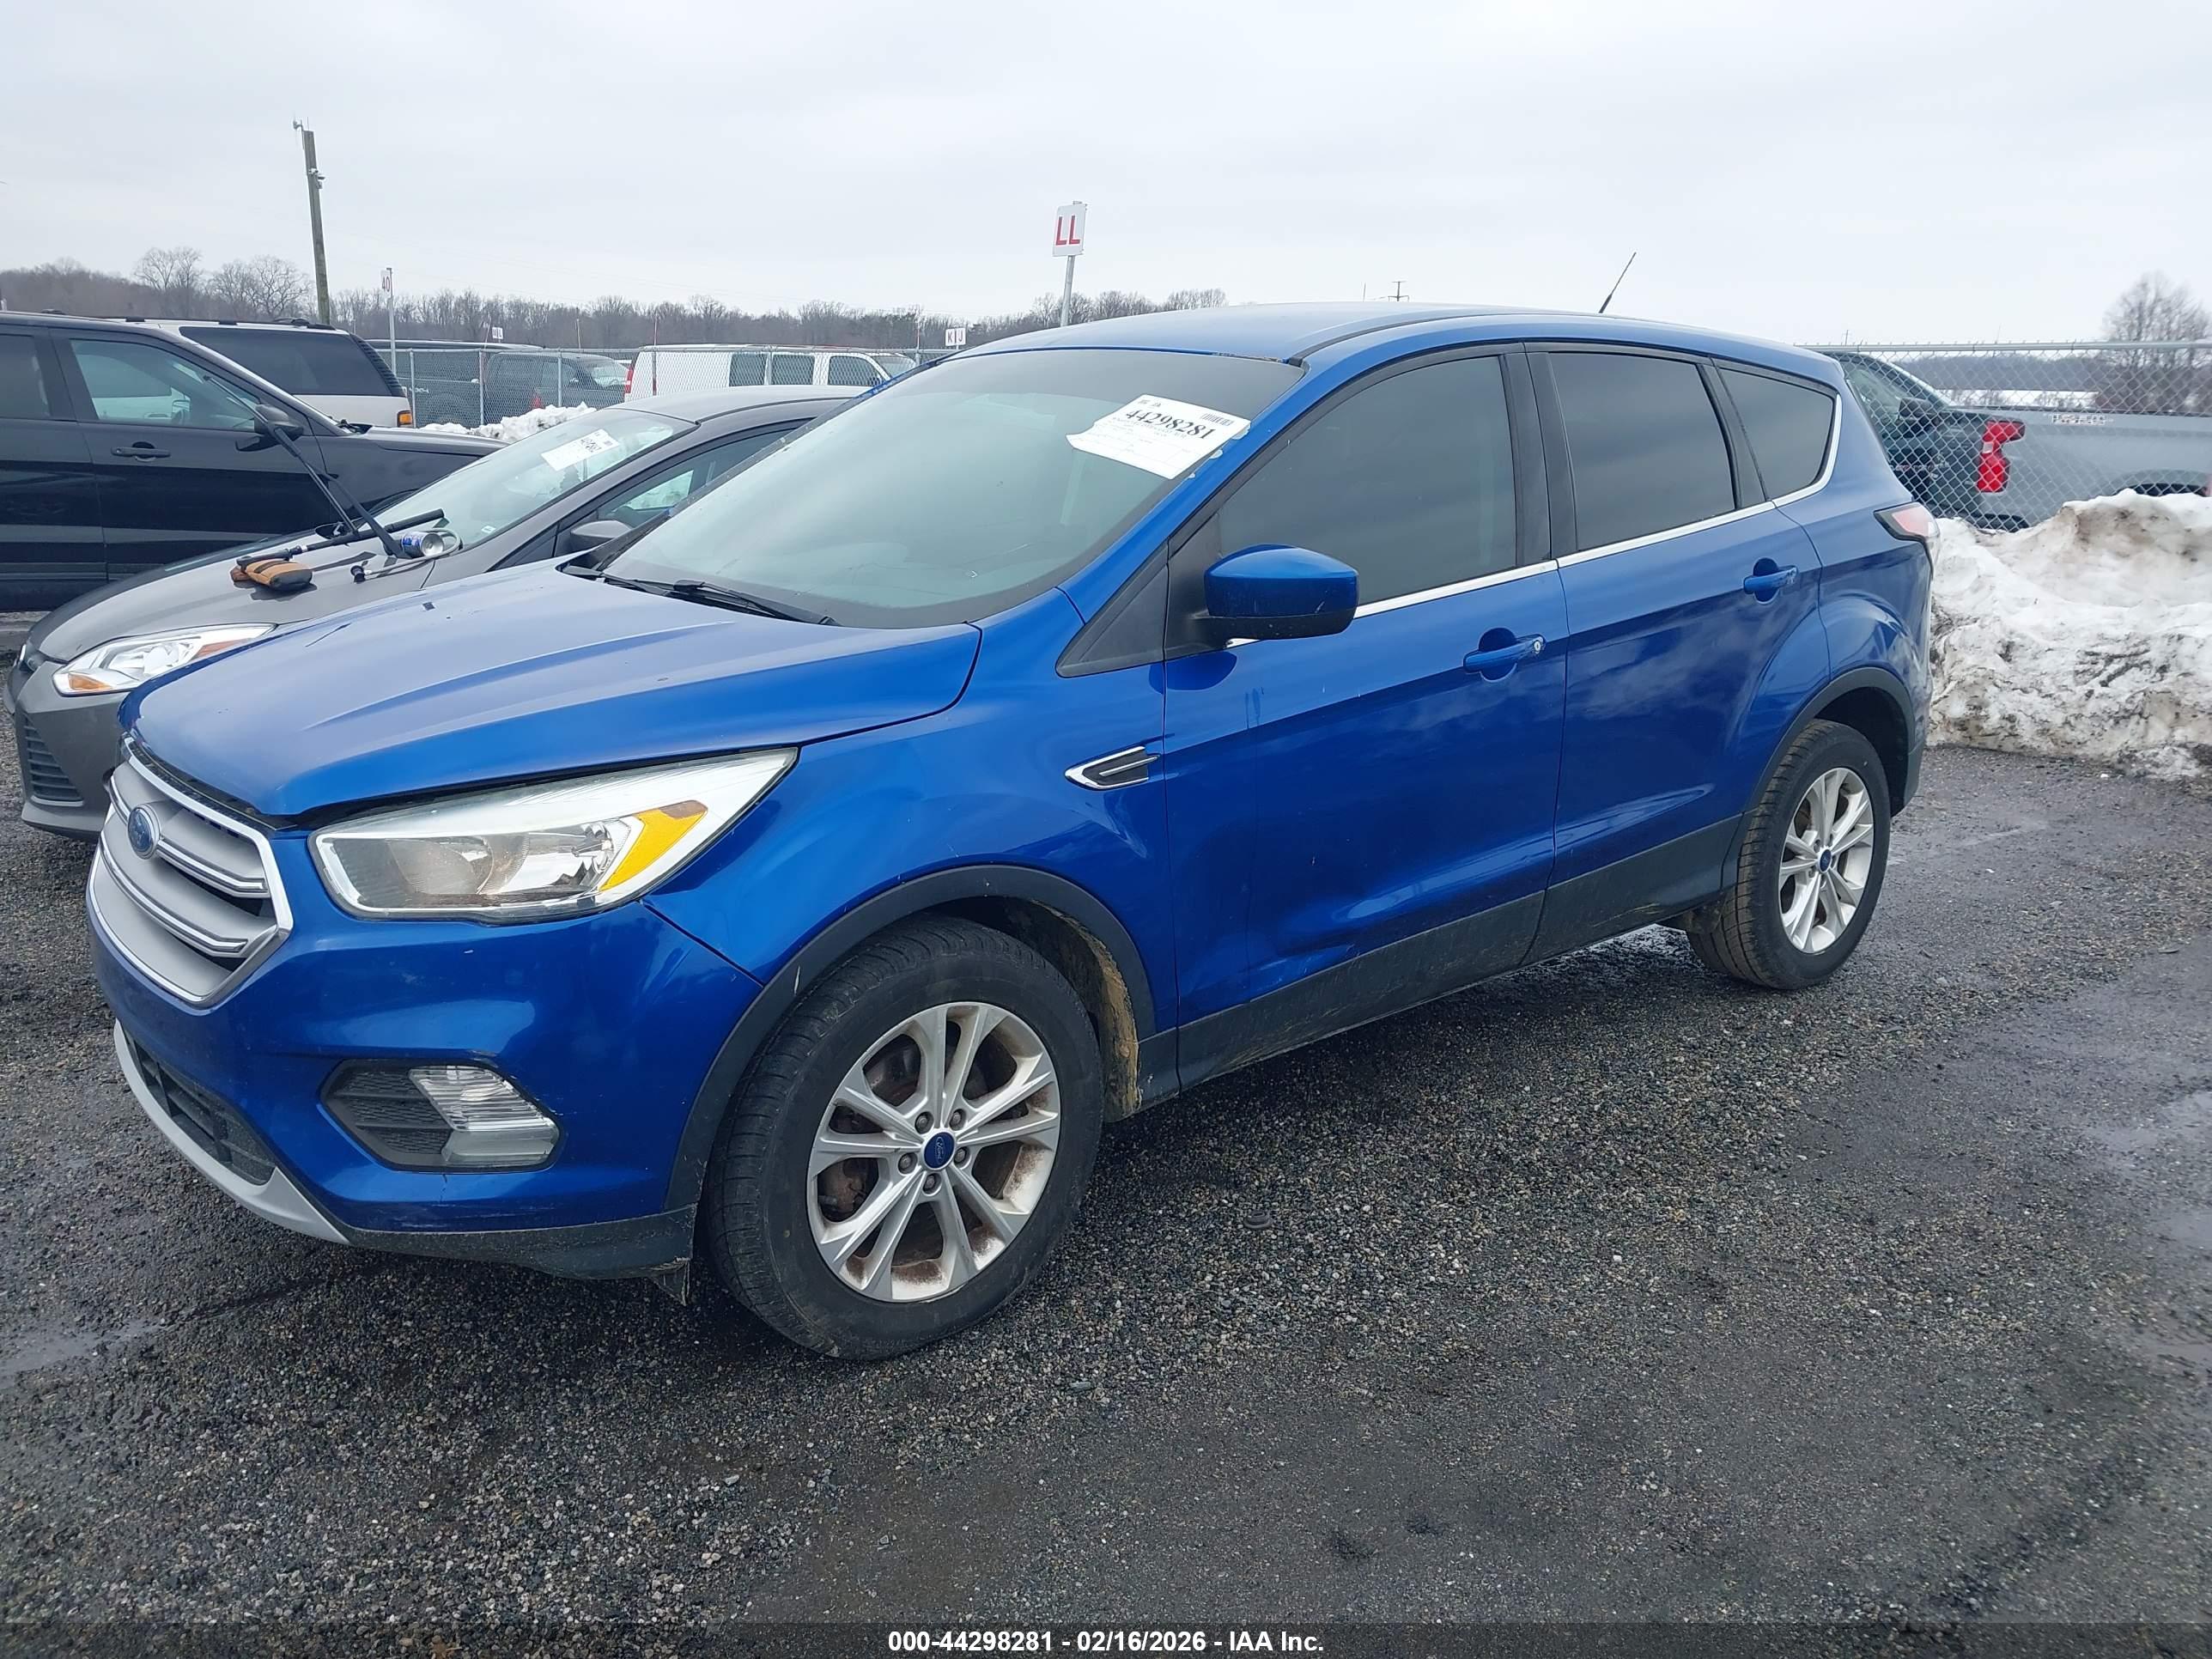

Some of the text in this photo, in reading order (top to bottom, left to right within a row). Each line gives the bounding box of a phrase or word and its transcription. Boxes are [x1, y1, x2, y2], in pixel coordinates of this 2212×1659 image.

[1055, 215, 1081, 246] LL
[381, 276, 391, 293] 40
[1126, 409, 1216, 439] 44298281
